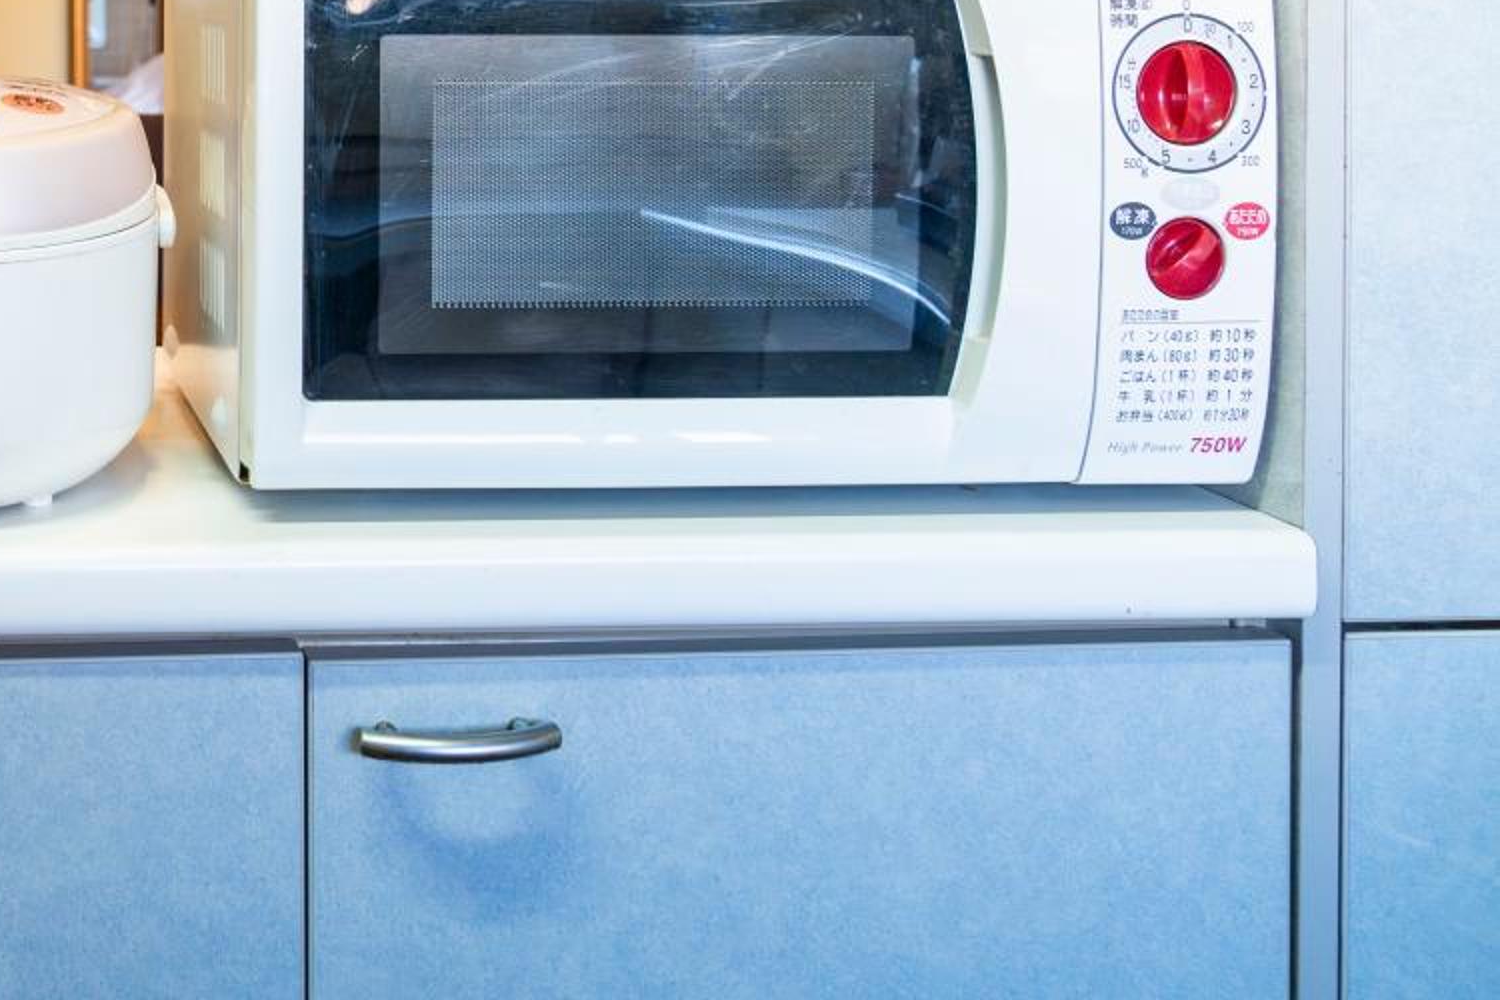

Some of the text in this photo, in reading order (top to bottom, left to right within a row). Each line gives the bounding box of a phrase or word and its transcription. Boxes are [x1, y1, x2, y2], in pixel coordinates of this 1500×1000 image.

[1249, 74, 1258, 89] 2
[1241, 120, 1251, 135] 3
[1161, 150, 1171, 164] 5
[1207, 150, 1217, 164] 4
[1190, 437, 1248, 453] 750W
